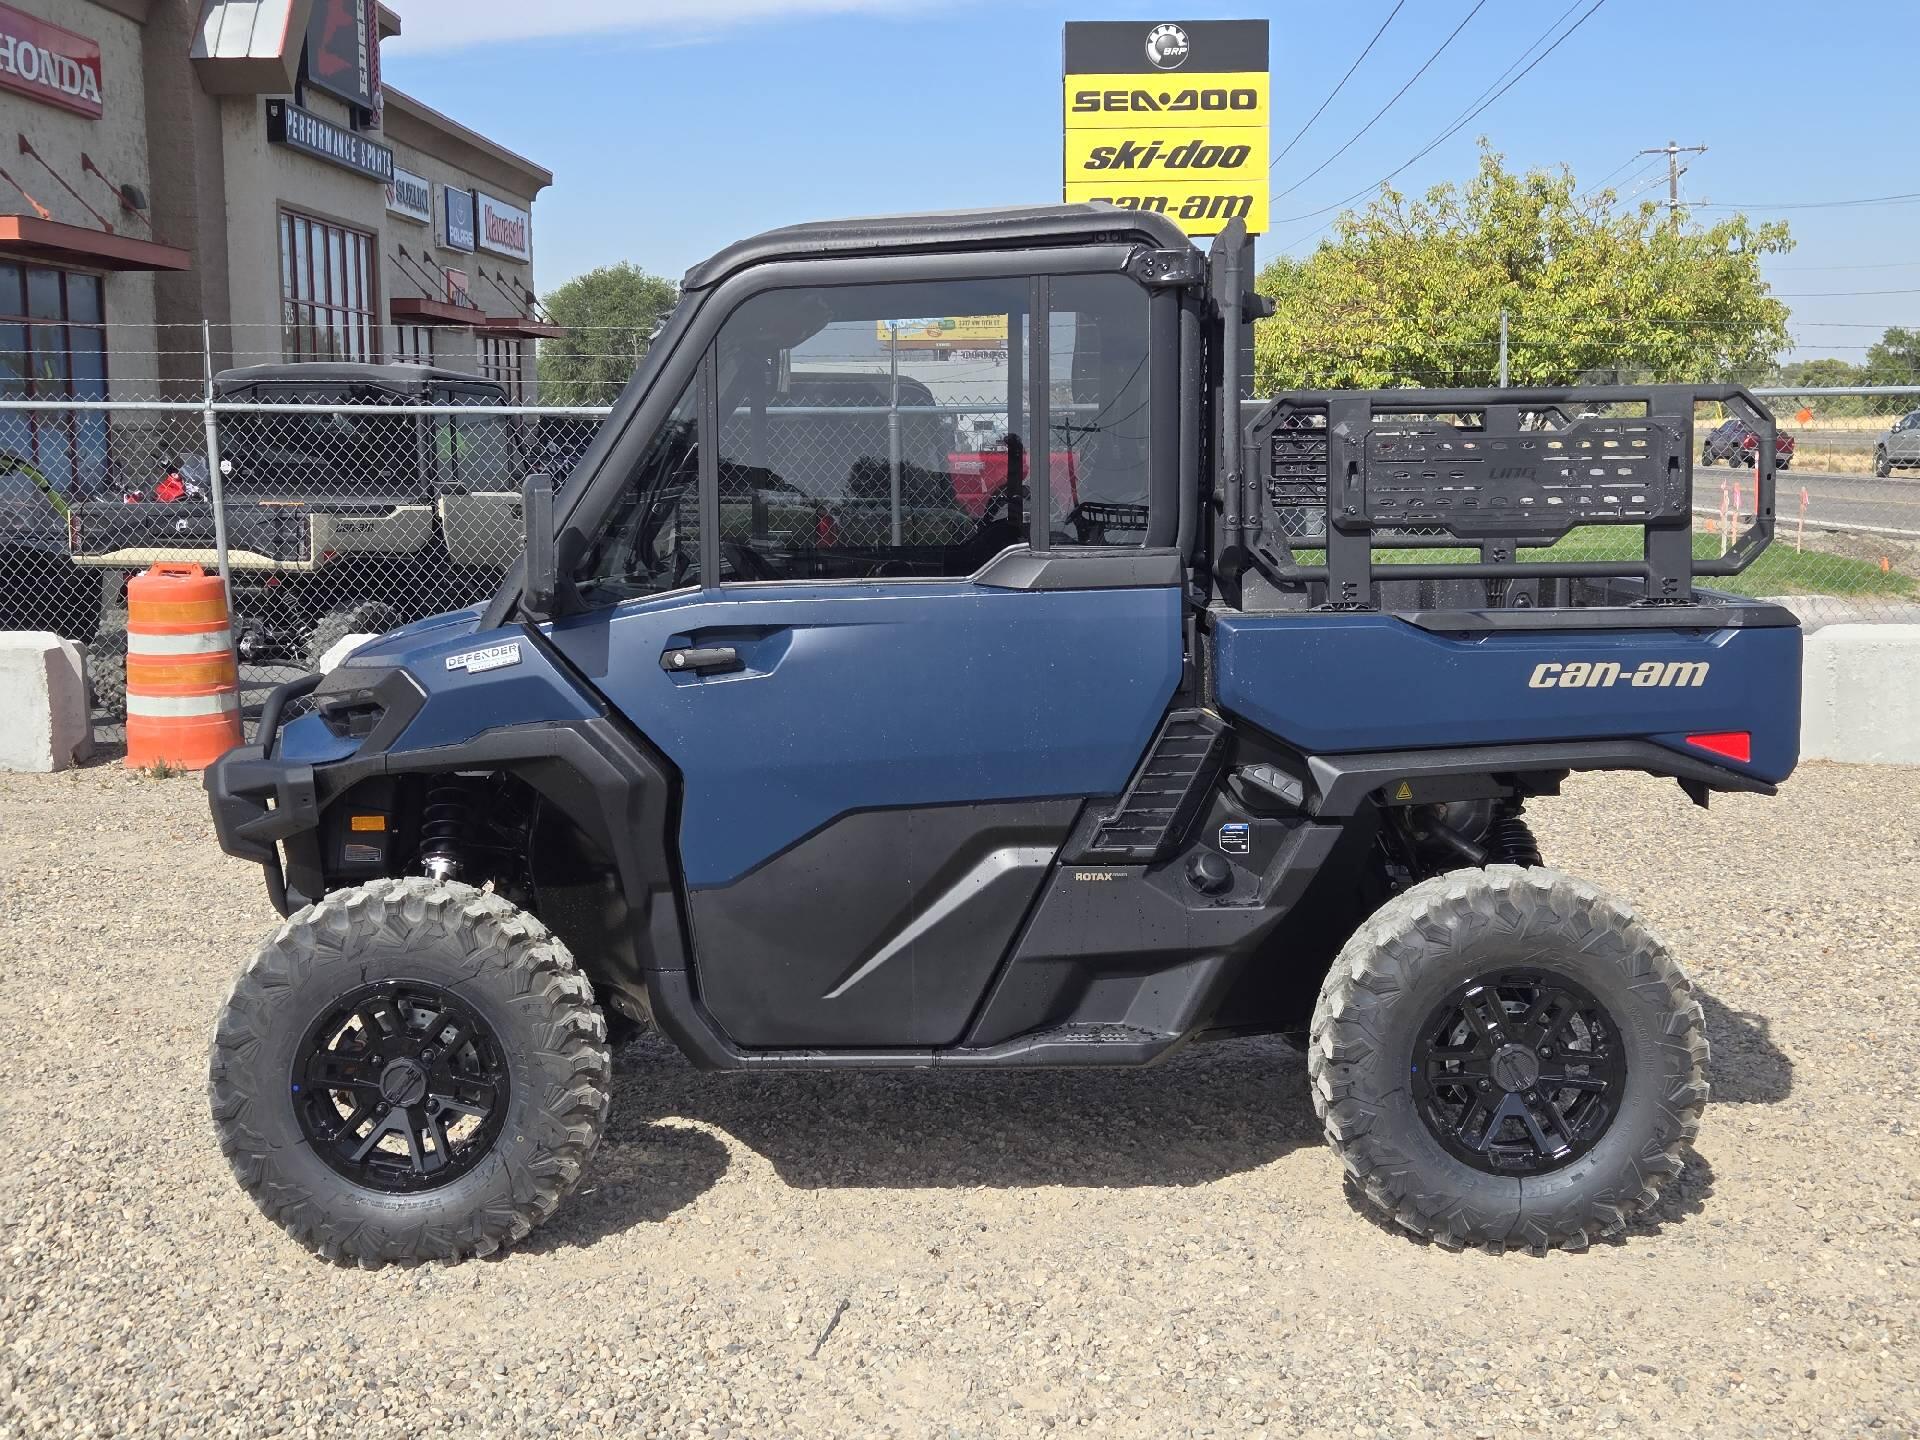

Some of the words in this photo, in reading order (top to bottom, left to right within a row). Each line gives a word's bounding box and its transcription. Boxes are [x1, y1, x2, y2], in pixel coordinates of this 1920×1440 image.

[1163, 47, 1187, 56] BRP
[0, 33, 102, 104] HONDA
[287, 109, 356, 162] PERFORMANCE
[361, 143, 392, 177] SPORTS
[1084, 140, 1251, 170] ski-doo
[395, 180, 429, 214] SUZUKI
[449, 226, 473, 243] POLARIS
[484, 204, 526, 253] Kawasaki
[448, 644, 517, 667] DEFENDER
[1528, 661, 1710, 688] can-am
[1075, 872, 1112, 881] ROTAX
